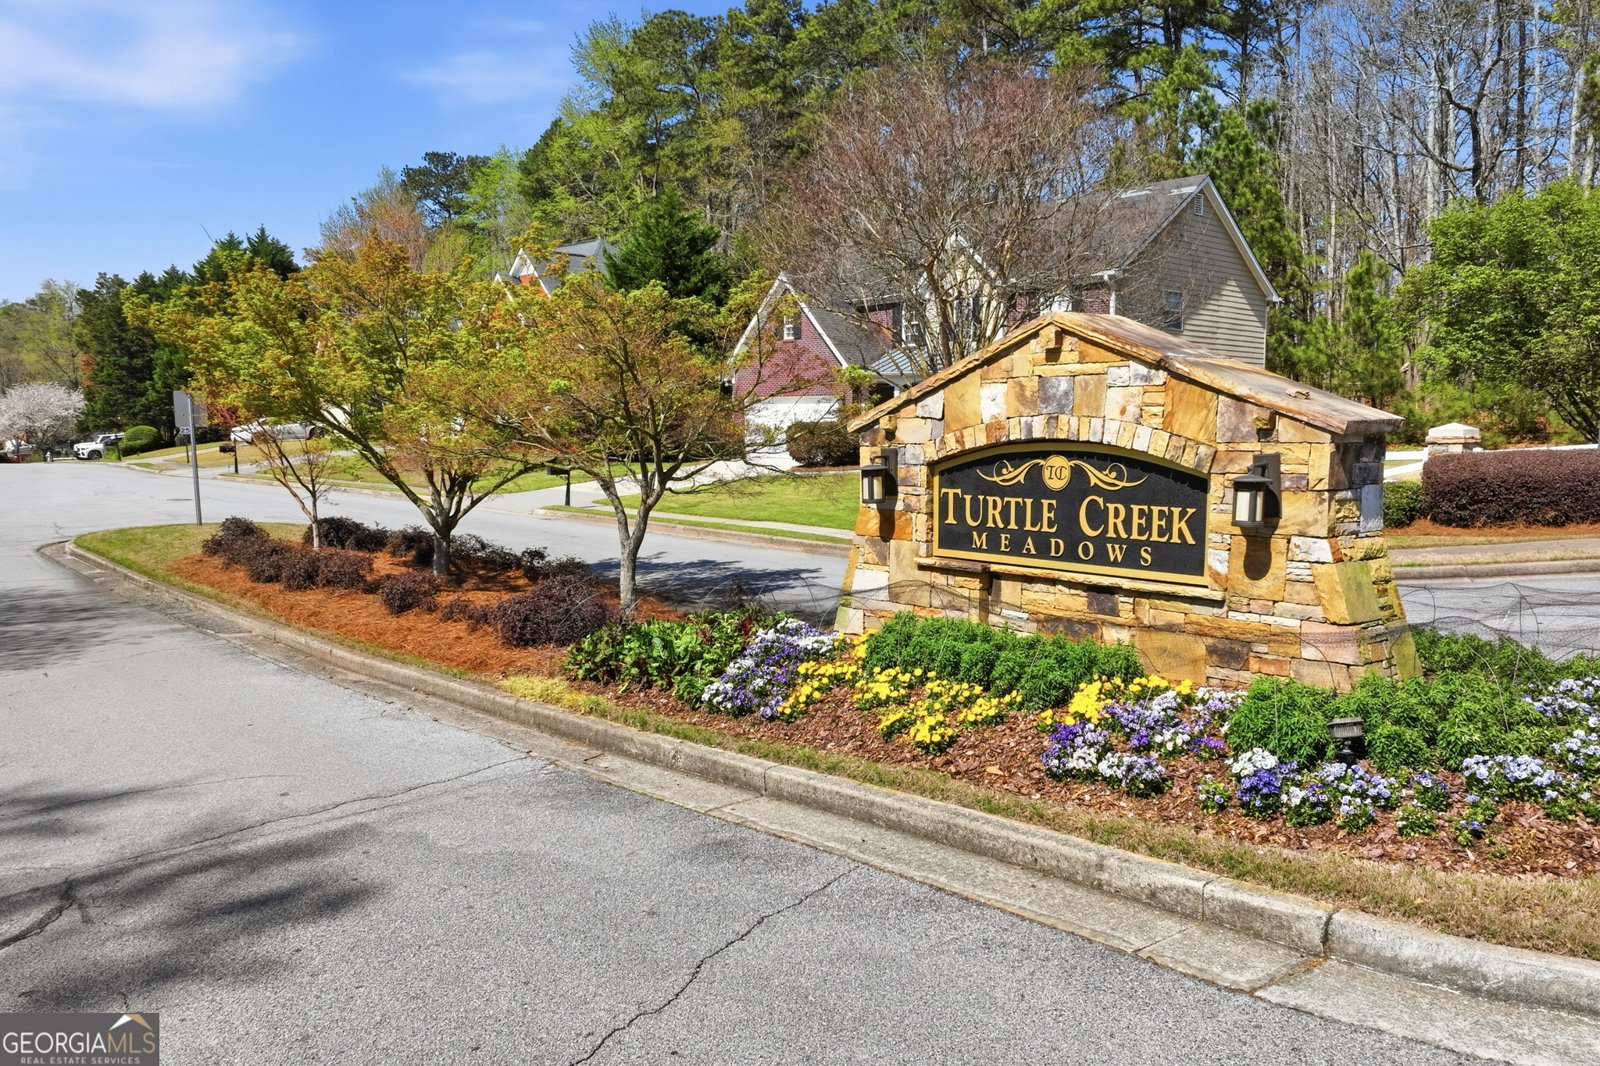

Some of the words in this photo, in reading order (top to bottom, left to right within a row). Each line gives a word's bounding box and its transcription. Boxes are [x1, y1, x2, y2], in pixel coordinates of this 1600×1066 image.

[1046, 466, 1067, 480] TC
[940, 488, 1057, 533] TURTLE
[1079, 495, 1197, 545] CREEK
[971, 531, 1152, 566] MEADOWS
